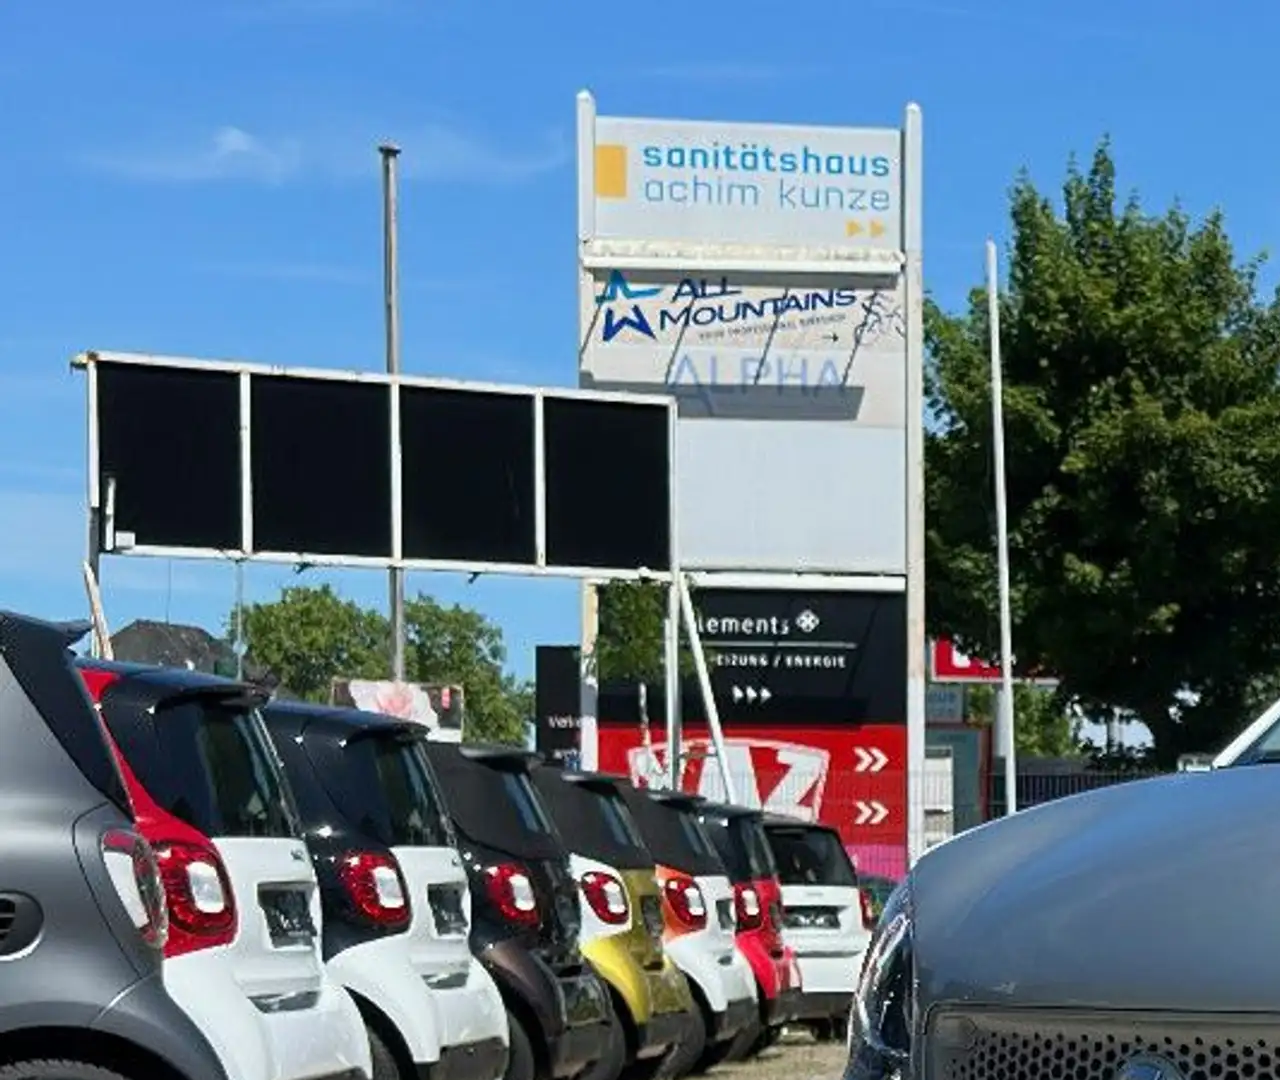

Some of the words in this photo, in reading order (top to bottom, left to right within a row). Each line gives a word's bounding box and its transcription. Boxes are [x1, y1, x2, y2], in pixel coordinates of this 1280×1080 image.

[643, 142, 889, 176] sanitätshaus
[644, 175, 760, 207] achim
[778, 178, 890, 211] kunze
[672, 276, 742, 304] ALL
[659, 288, 857, 331] MOUNTAINS
[667, 353, 846, 410] ALPHA
[698, 615, 790, 635] lements
